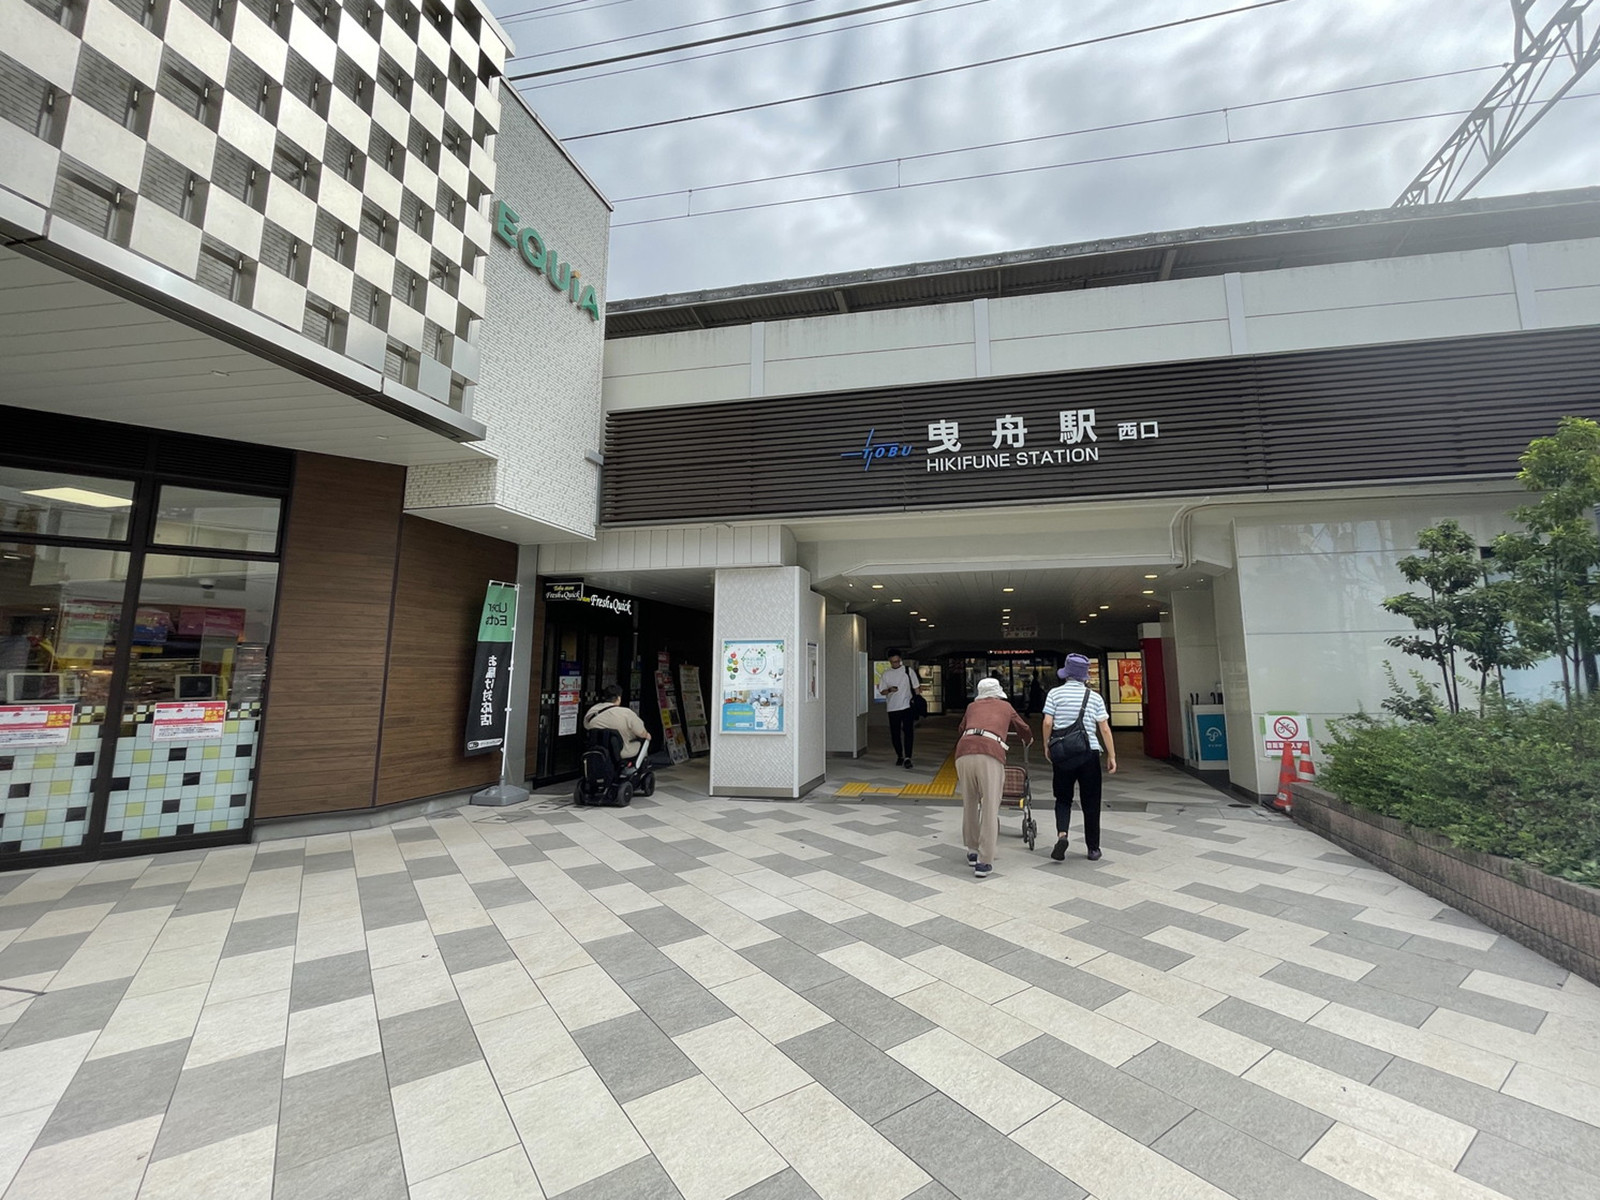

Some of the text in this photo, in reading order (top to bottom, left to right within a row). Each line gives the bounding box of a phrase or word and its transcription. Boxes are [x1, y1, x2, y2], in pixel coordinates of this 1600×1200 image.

[927, 408, 1160, 454] 曳舟駅 西口
[926, 447, 1099, 472] HIKIFUNE STATION
